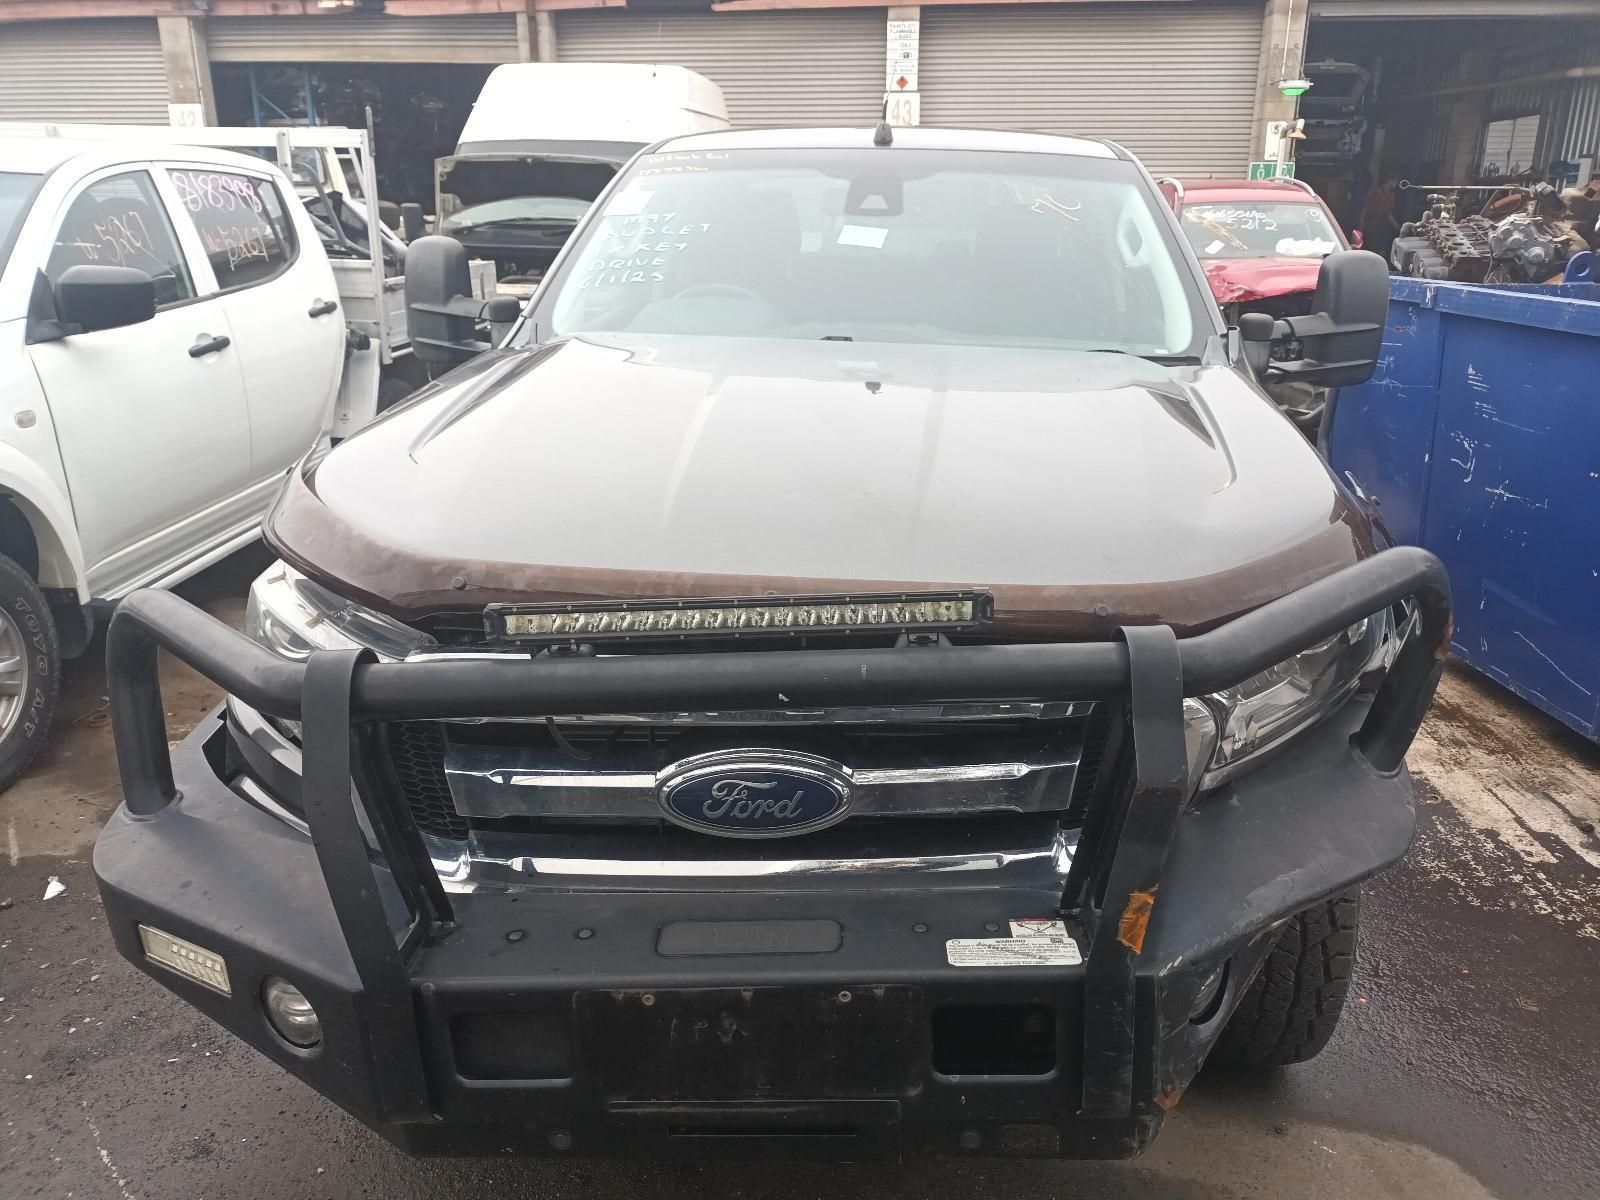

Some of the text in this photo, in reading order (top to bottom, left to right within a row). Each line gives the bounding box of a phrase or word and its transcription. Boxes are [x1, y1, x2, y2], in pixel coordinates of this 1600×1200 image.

[891, 99, 912, 125] 43
[1226, 218, 1279, 231] 5212
[15, 597, 48, 676] TOYO
[702, 779, 804, 819] Ford
